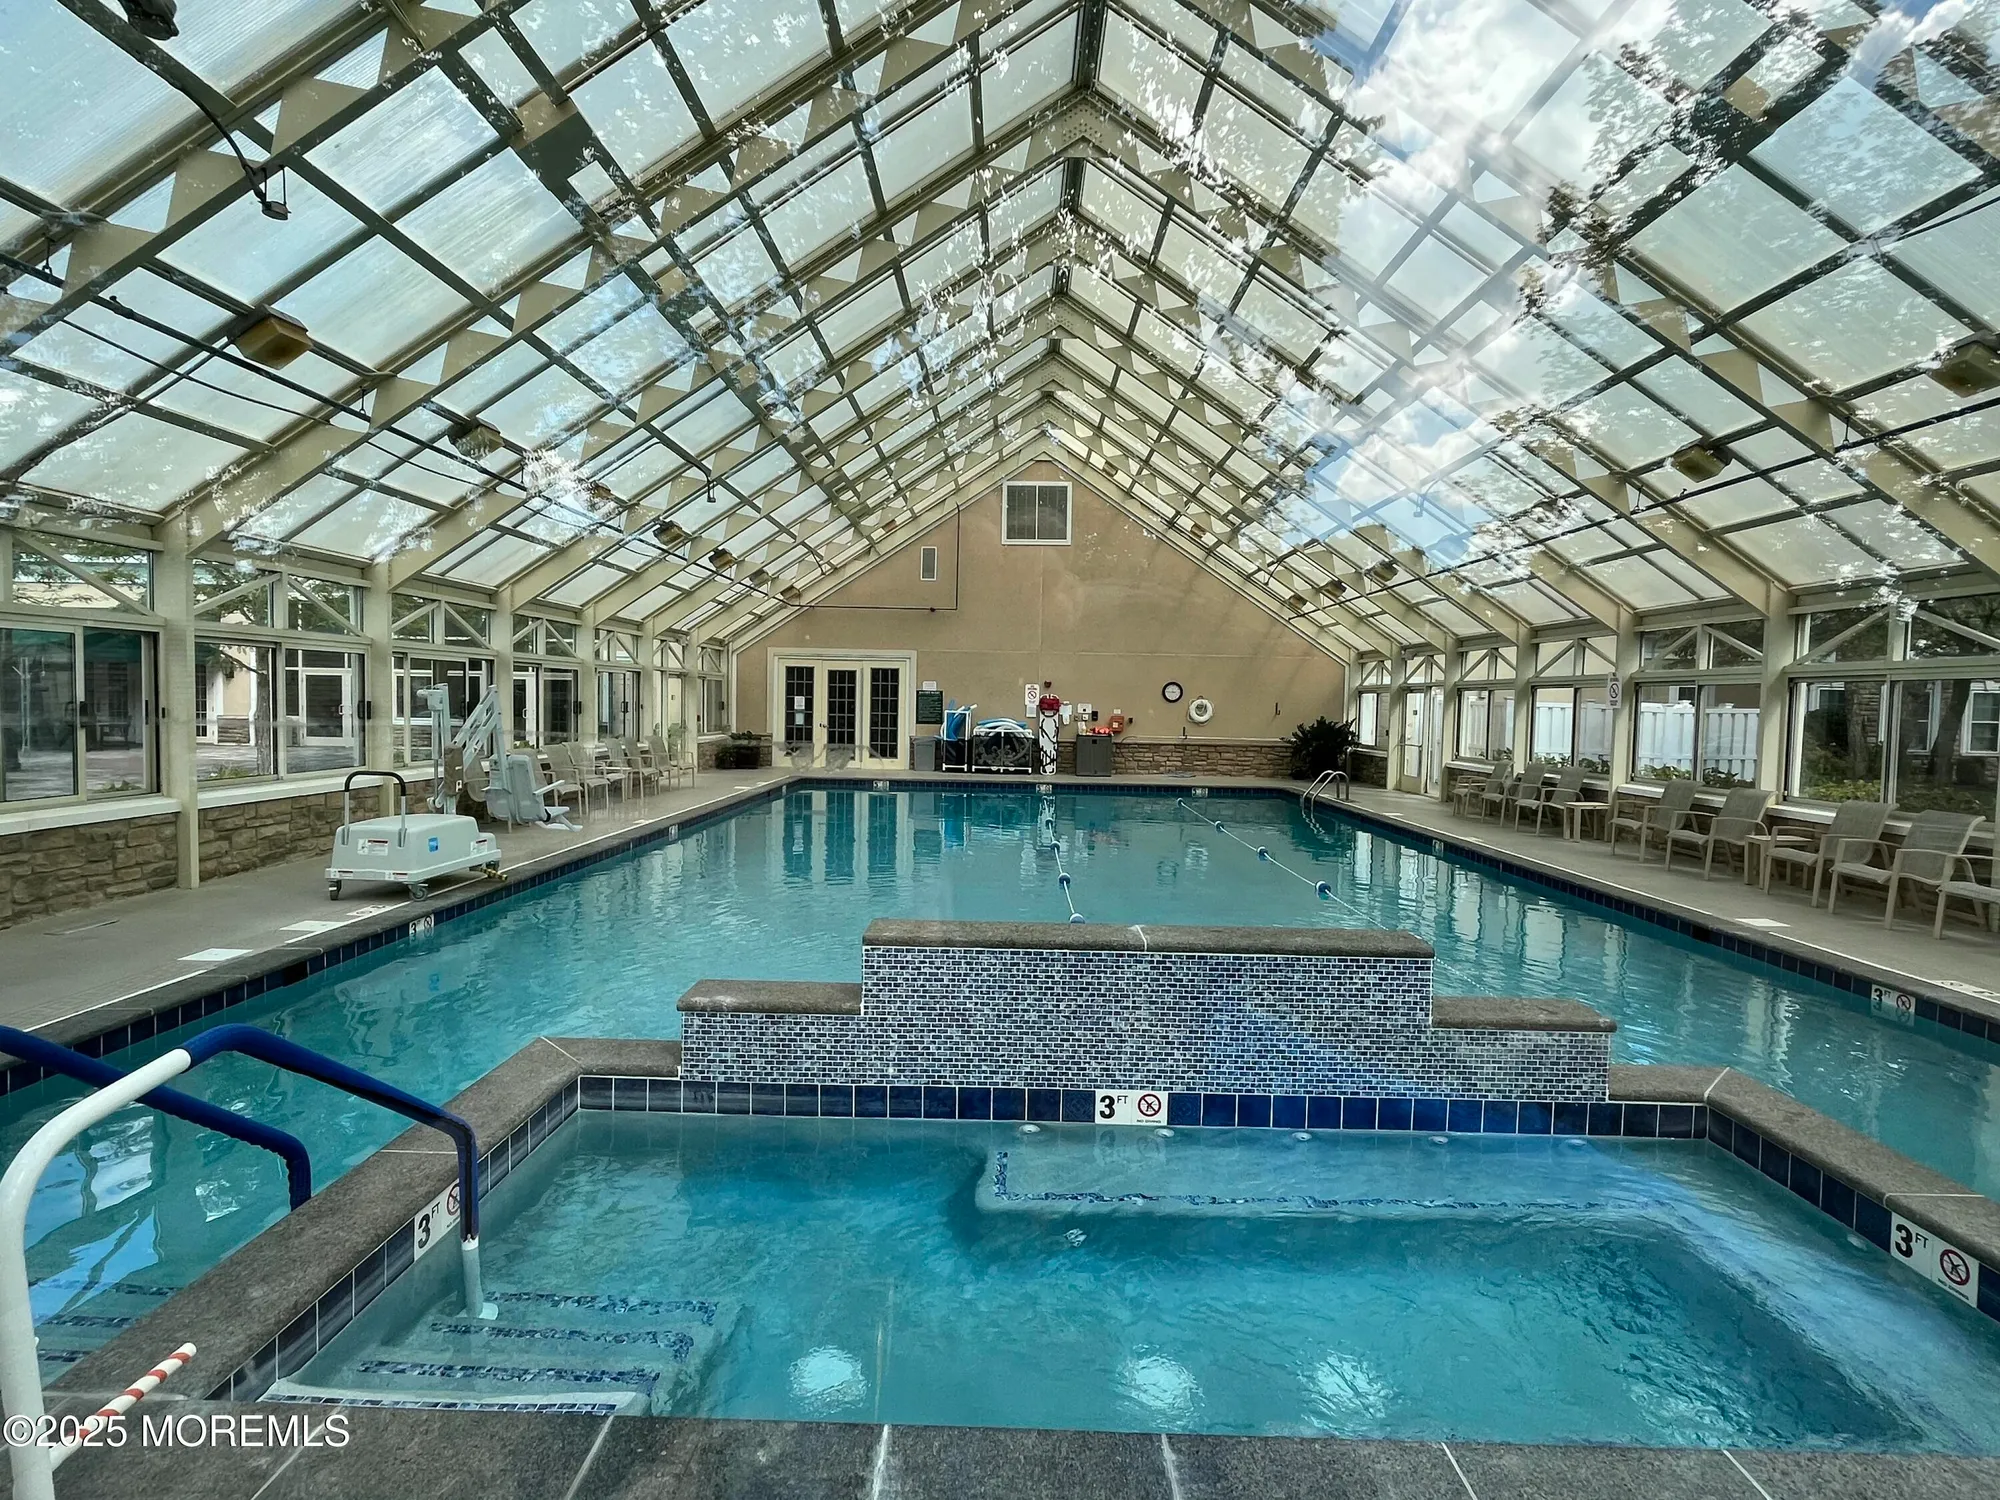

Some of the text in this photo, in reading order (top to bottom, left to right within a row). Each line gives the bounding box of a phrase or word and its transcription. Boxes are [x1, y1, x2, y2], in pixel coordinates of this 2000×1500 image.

[411, 922, 416, 935] 3
[1873, 987, 1883, 1002] 3
[1099, 1095, 1128, 1119] 3 FT
[418, 1201, 441, 1249] 3 FT
[1895, 1223, 1929, 1258] 3 FT
